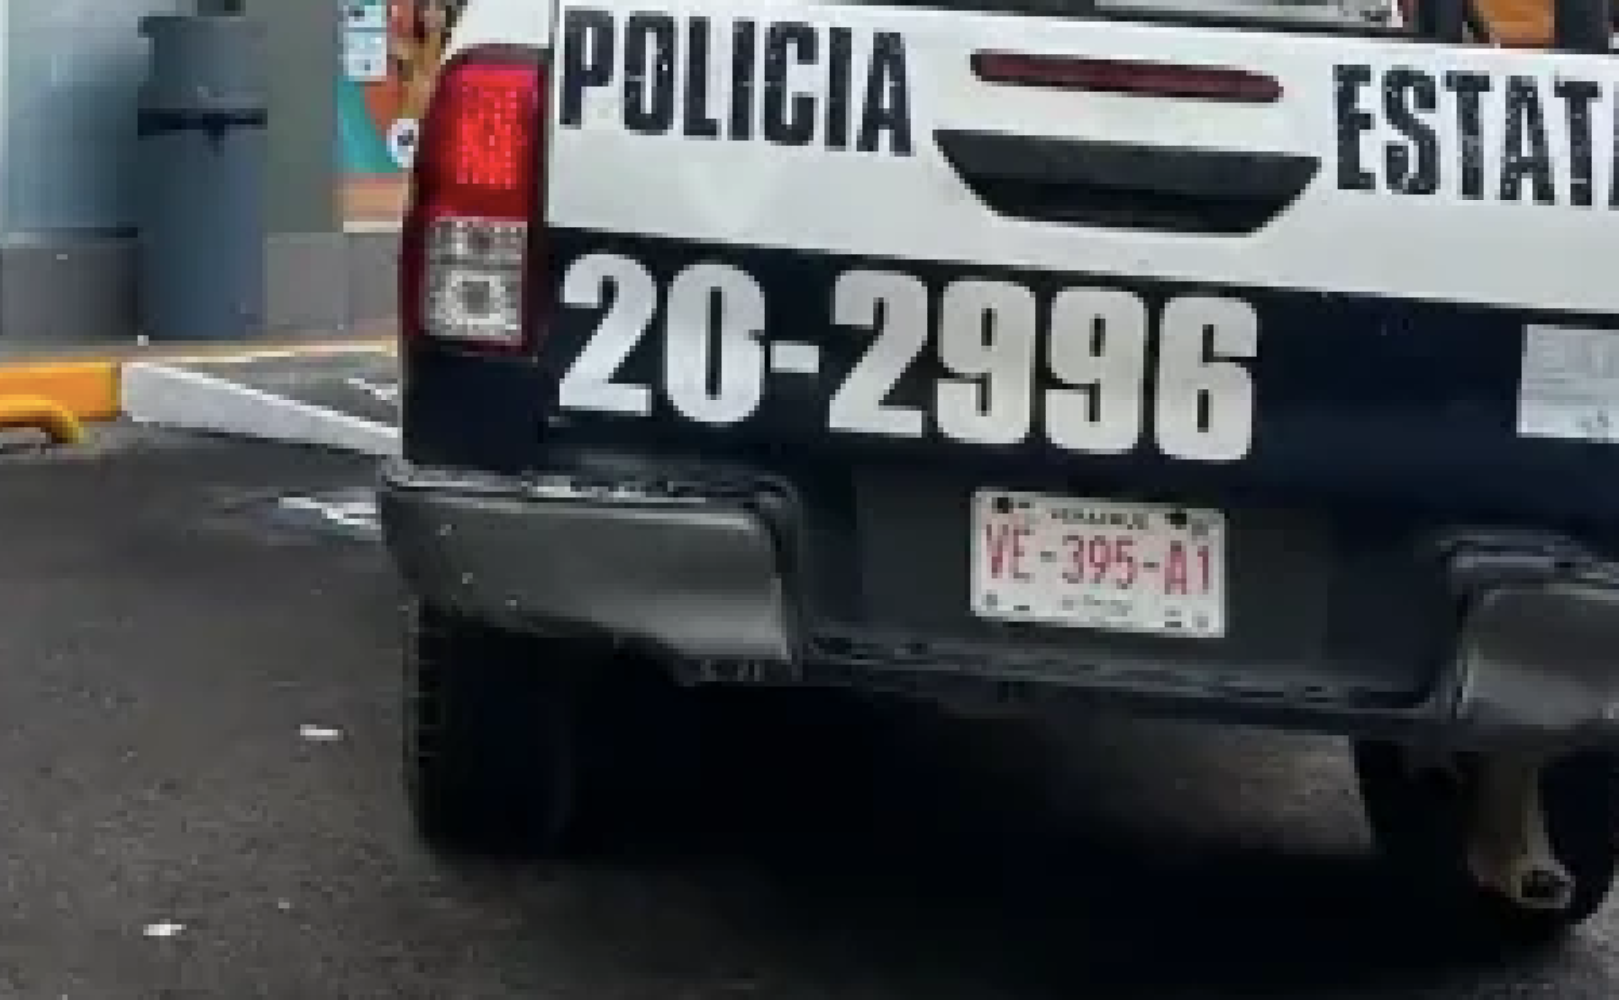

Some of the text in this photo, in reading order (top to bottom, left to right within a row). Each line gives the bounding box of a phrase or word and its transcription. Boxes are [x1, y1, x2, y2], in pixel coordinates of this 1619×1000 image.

[559, 9, 915, 158] POLICIA
[1333, 63, 1619, 210] ESTAT
[558, 253, 1260, 461] 20-2996
[984, 523, 1211, 596] VE-395-A1
